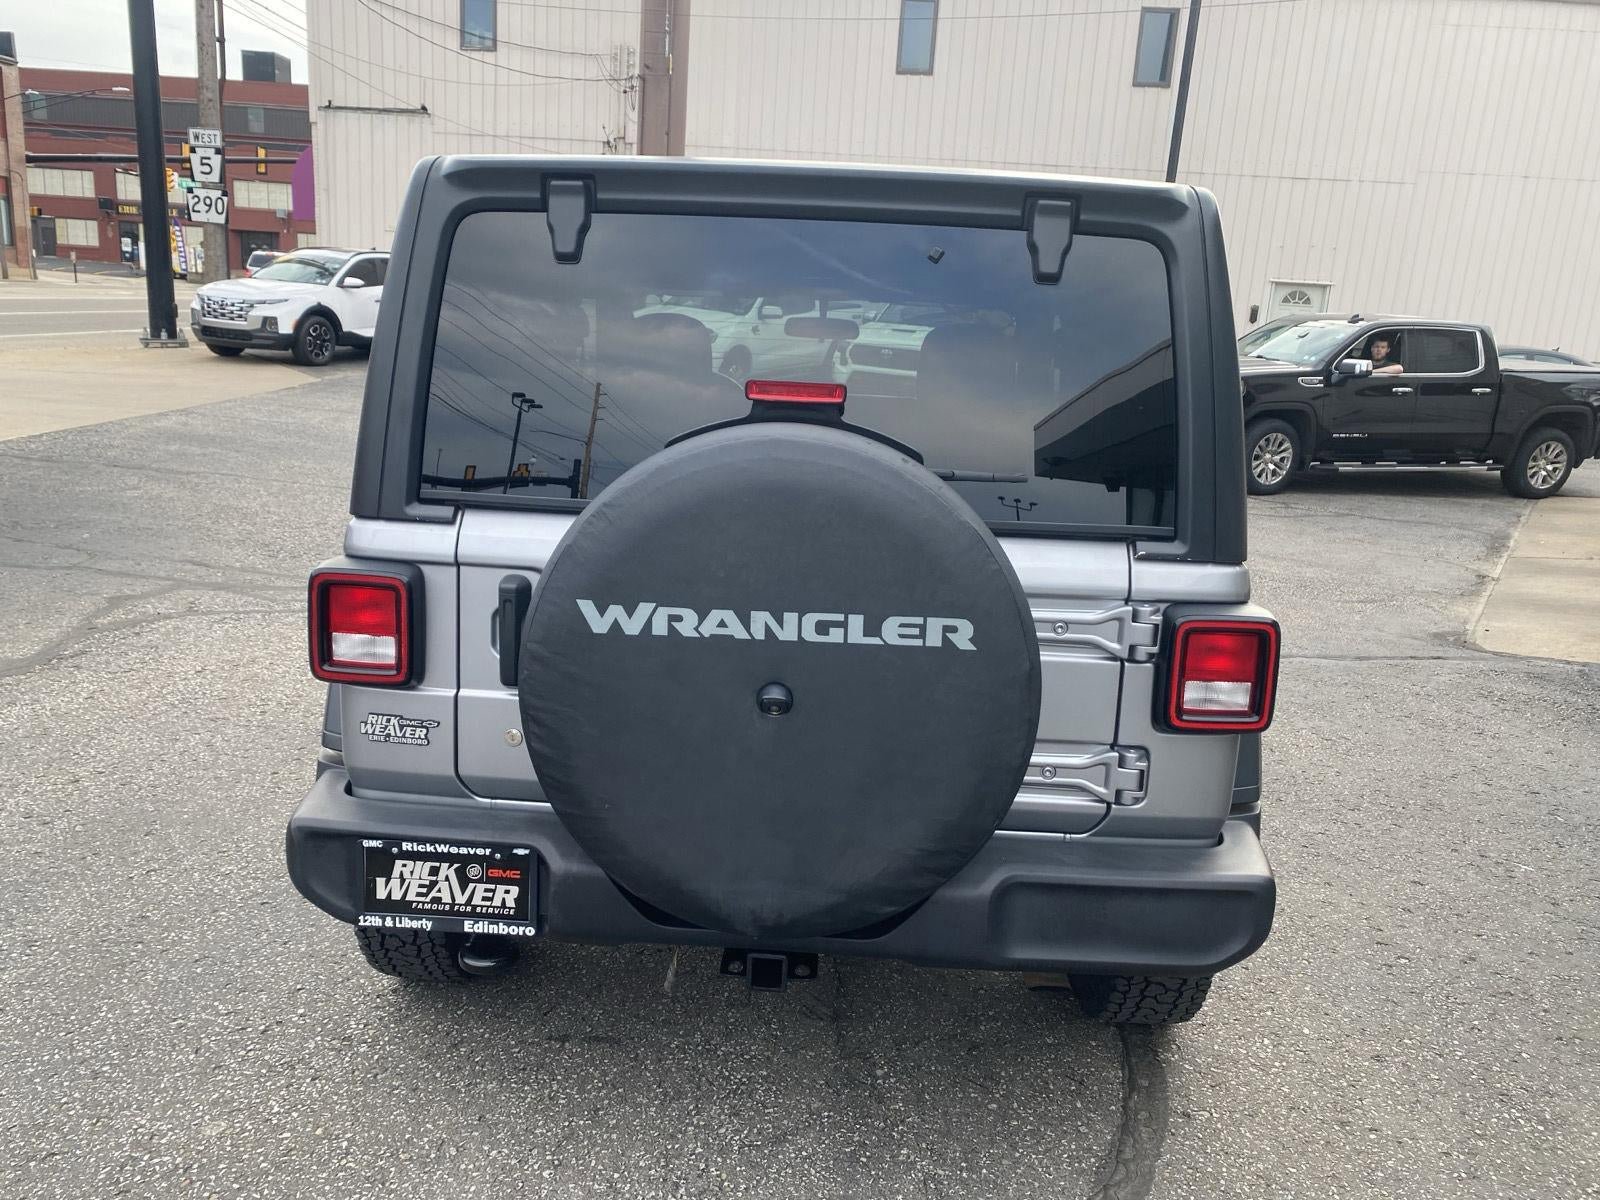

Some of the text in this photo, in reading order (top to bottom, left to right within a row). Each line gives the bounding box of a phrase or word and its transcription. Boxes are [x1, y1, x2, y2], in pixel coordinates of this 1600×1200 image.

[192, 131, 218, 145] WEST
[199, 156, 213, 175] 5
[191, 194, 225, 215] 290
[575, 598, 977, 651] WRANGLER
[367, 714, 422, 727] RICK GMC
[360, 722, 427, 739] WEAVER
[390, 736, 428, 745] EDINBORO
[362, 839, 492, 856] GMC RickWeaver
[391, 859, 521, 881] RICK GMC
[375, 877, 520, 908] WEAVER
[411, 902, 515, 915] FAMOUS FOR SERVICE
[358, 915, 433, 930] 12th & Liberty
[463, 920, 536, 936] Edinboro
